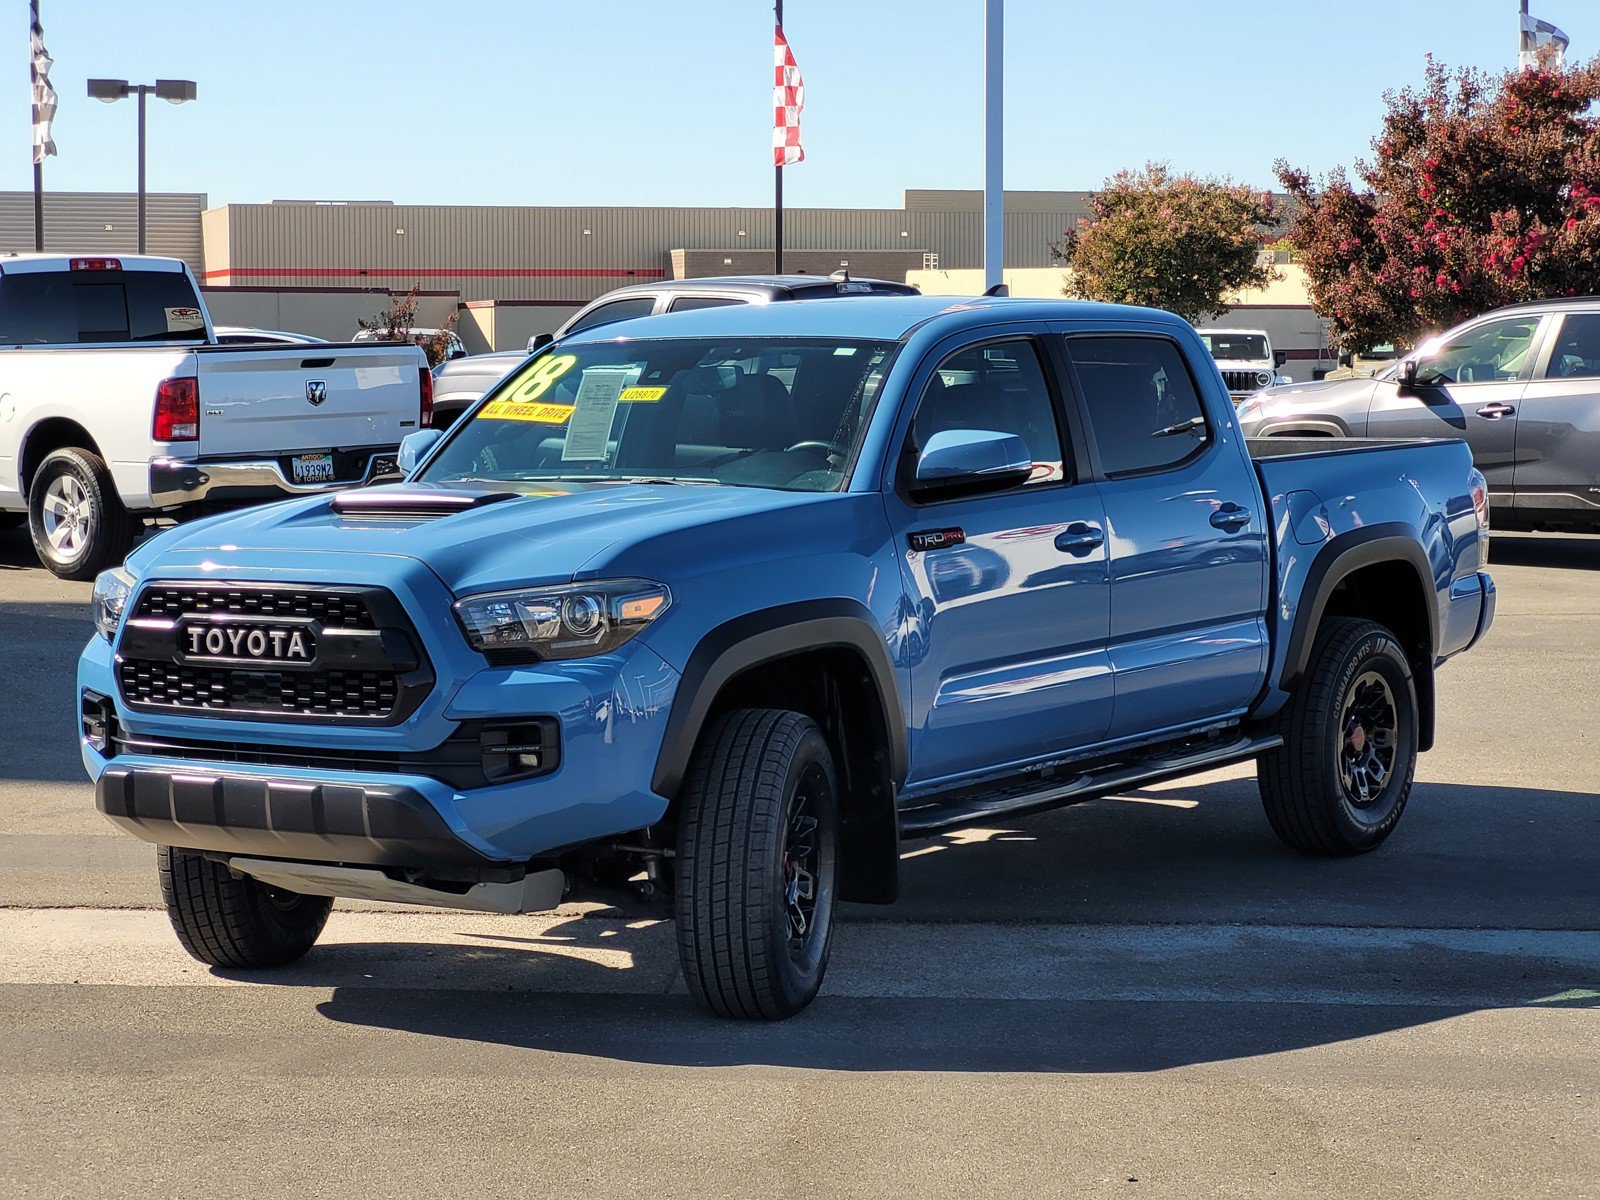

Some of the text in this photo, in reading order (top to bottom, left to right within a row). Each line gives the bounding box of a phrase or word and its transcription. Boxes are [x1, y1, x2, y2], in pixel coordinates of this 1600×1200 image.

[495, 354, 577, 403] 18
[624, 390, 659, 399] U28870
[484, 404, 571, 419] ALL WHEEL DRIVE
[301, 453, 324, 461] ANTIOCH
[294, 463, 332, 478] 41939M2
[303, 475, 327, 483] TOYOTA
[914, 532, 944, 547] TRD
[187, 627, 308, 658] TOYOTA
[1333, 656, 1359, 719] COMMANDO
